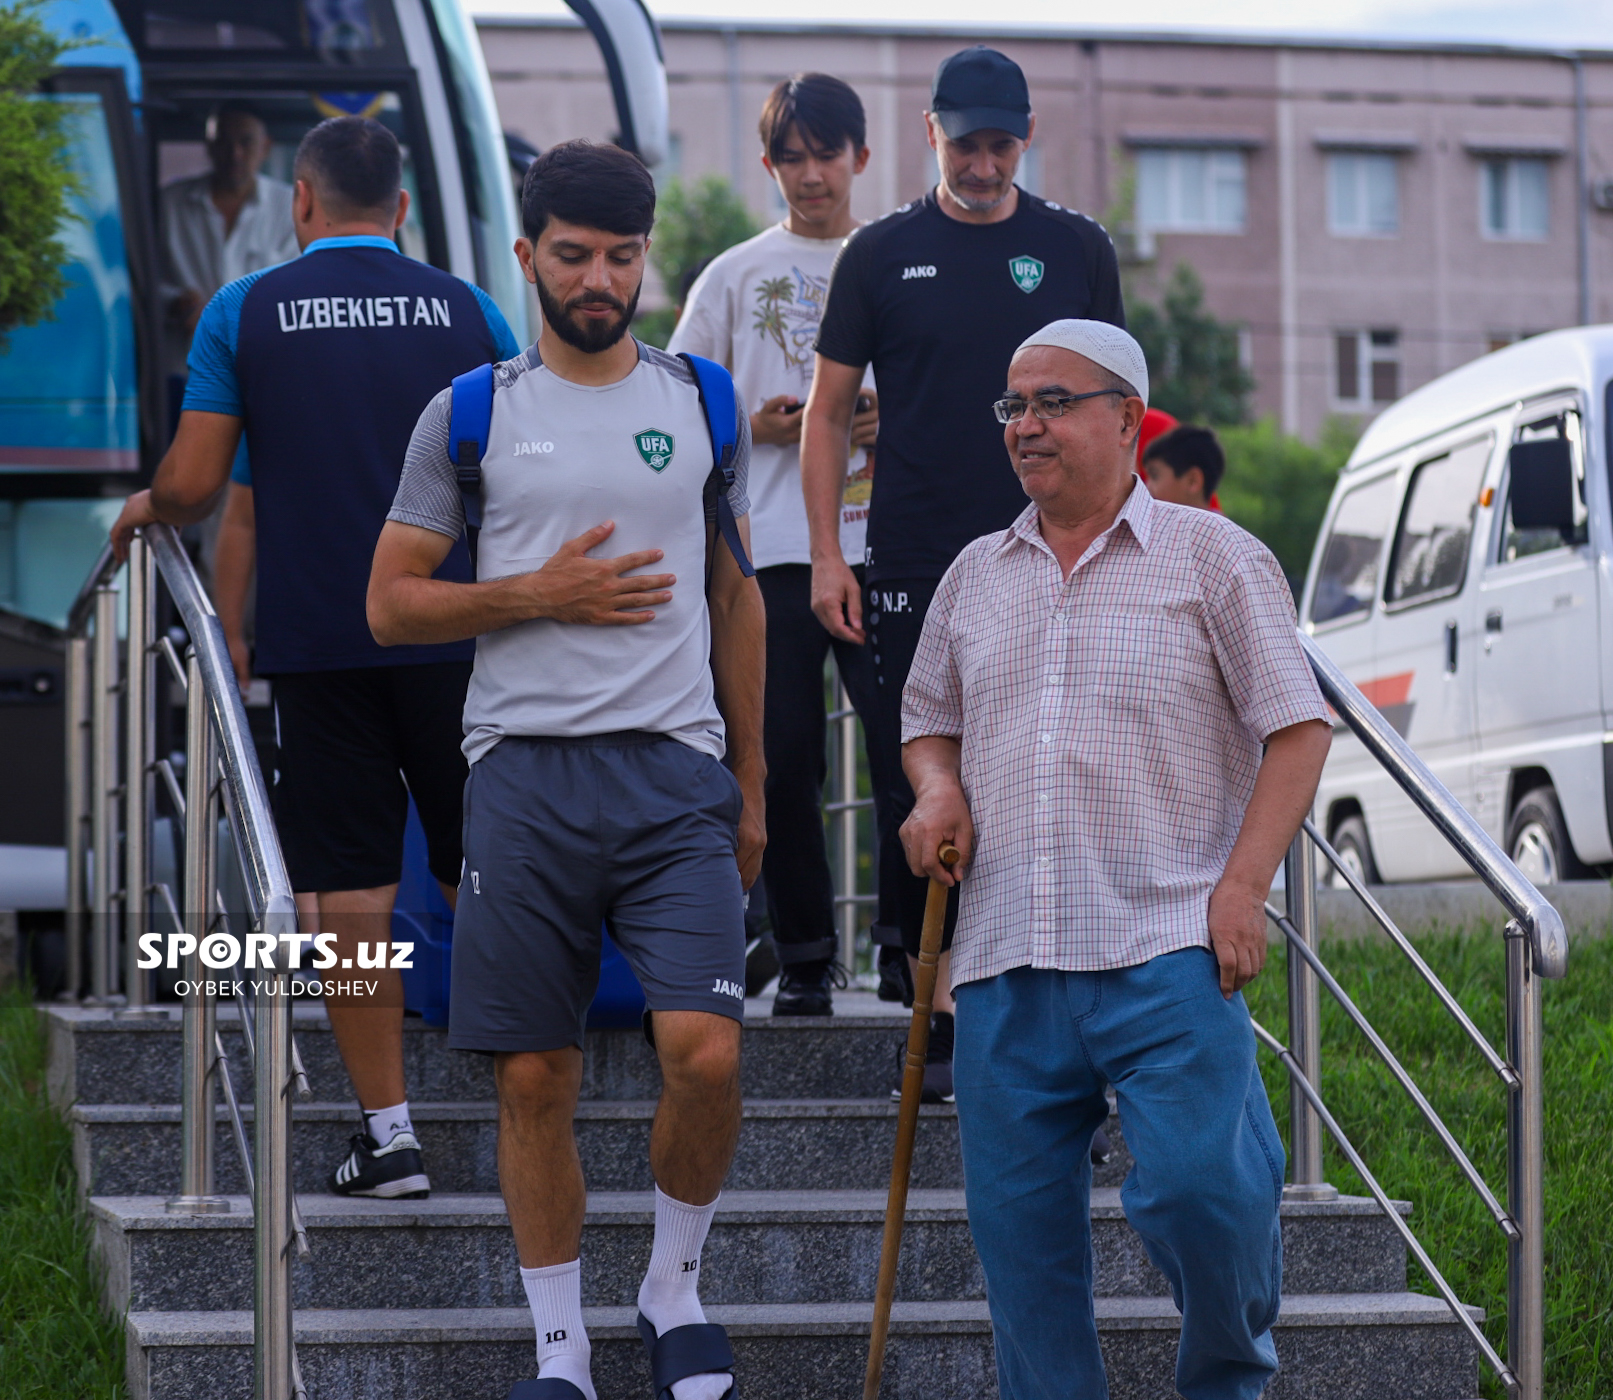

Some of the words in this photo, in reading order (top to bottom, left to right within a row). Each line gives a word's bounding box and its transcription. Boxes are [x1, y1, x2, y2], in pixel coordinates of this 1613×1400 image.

[902, 265, 937, 280] JAKO
[1015, 261, 1039, 277] UFA
[277, 296, 451, 333] UZBEKISTAN
[513, 441, 554, 457] JAKO
[640, 437, 670, 452] UFA
[882, 592, 912, 613] N.P.
[712, 978, 743, 1000] JAKO
[681, 1259, 698, 1273] 10
[545, 1329, 567, 1344] 10
